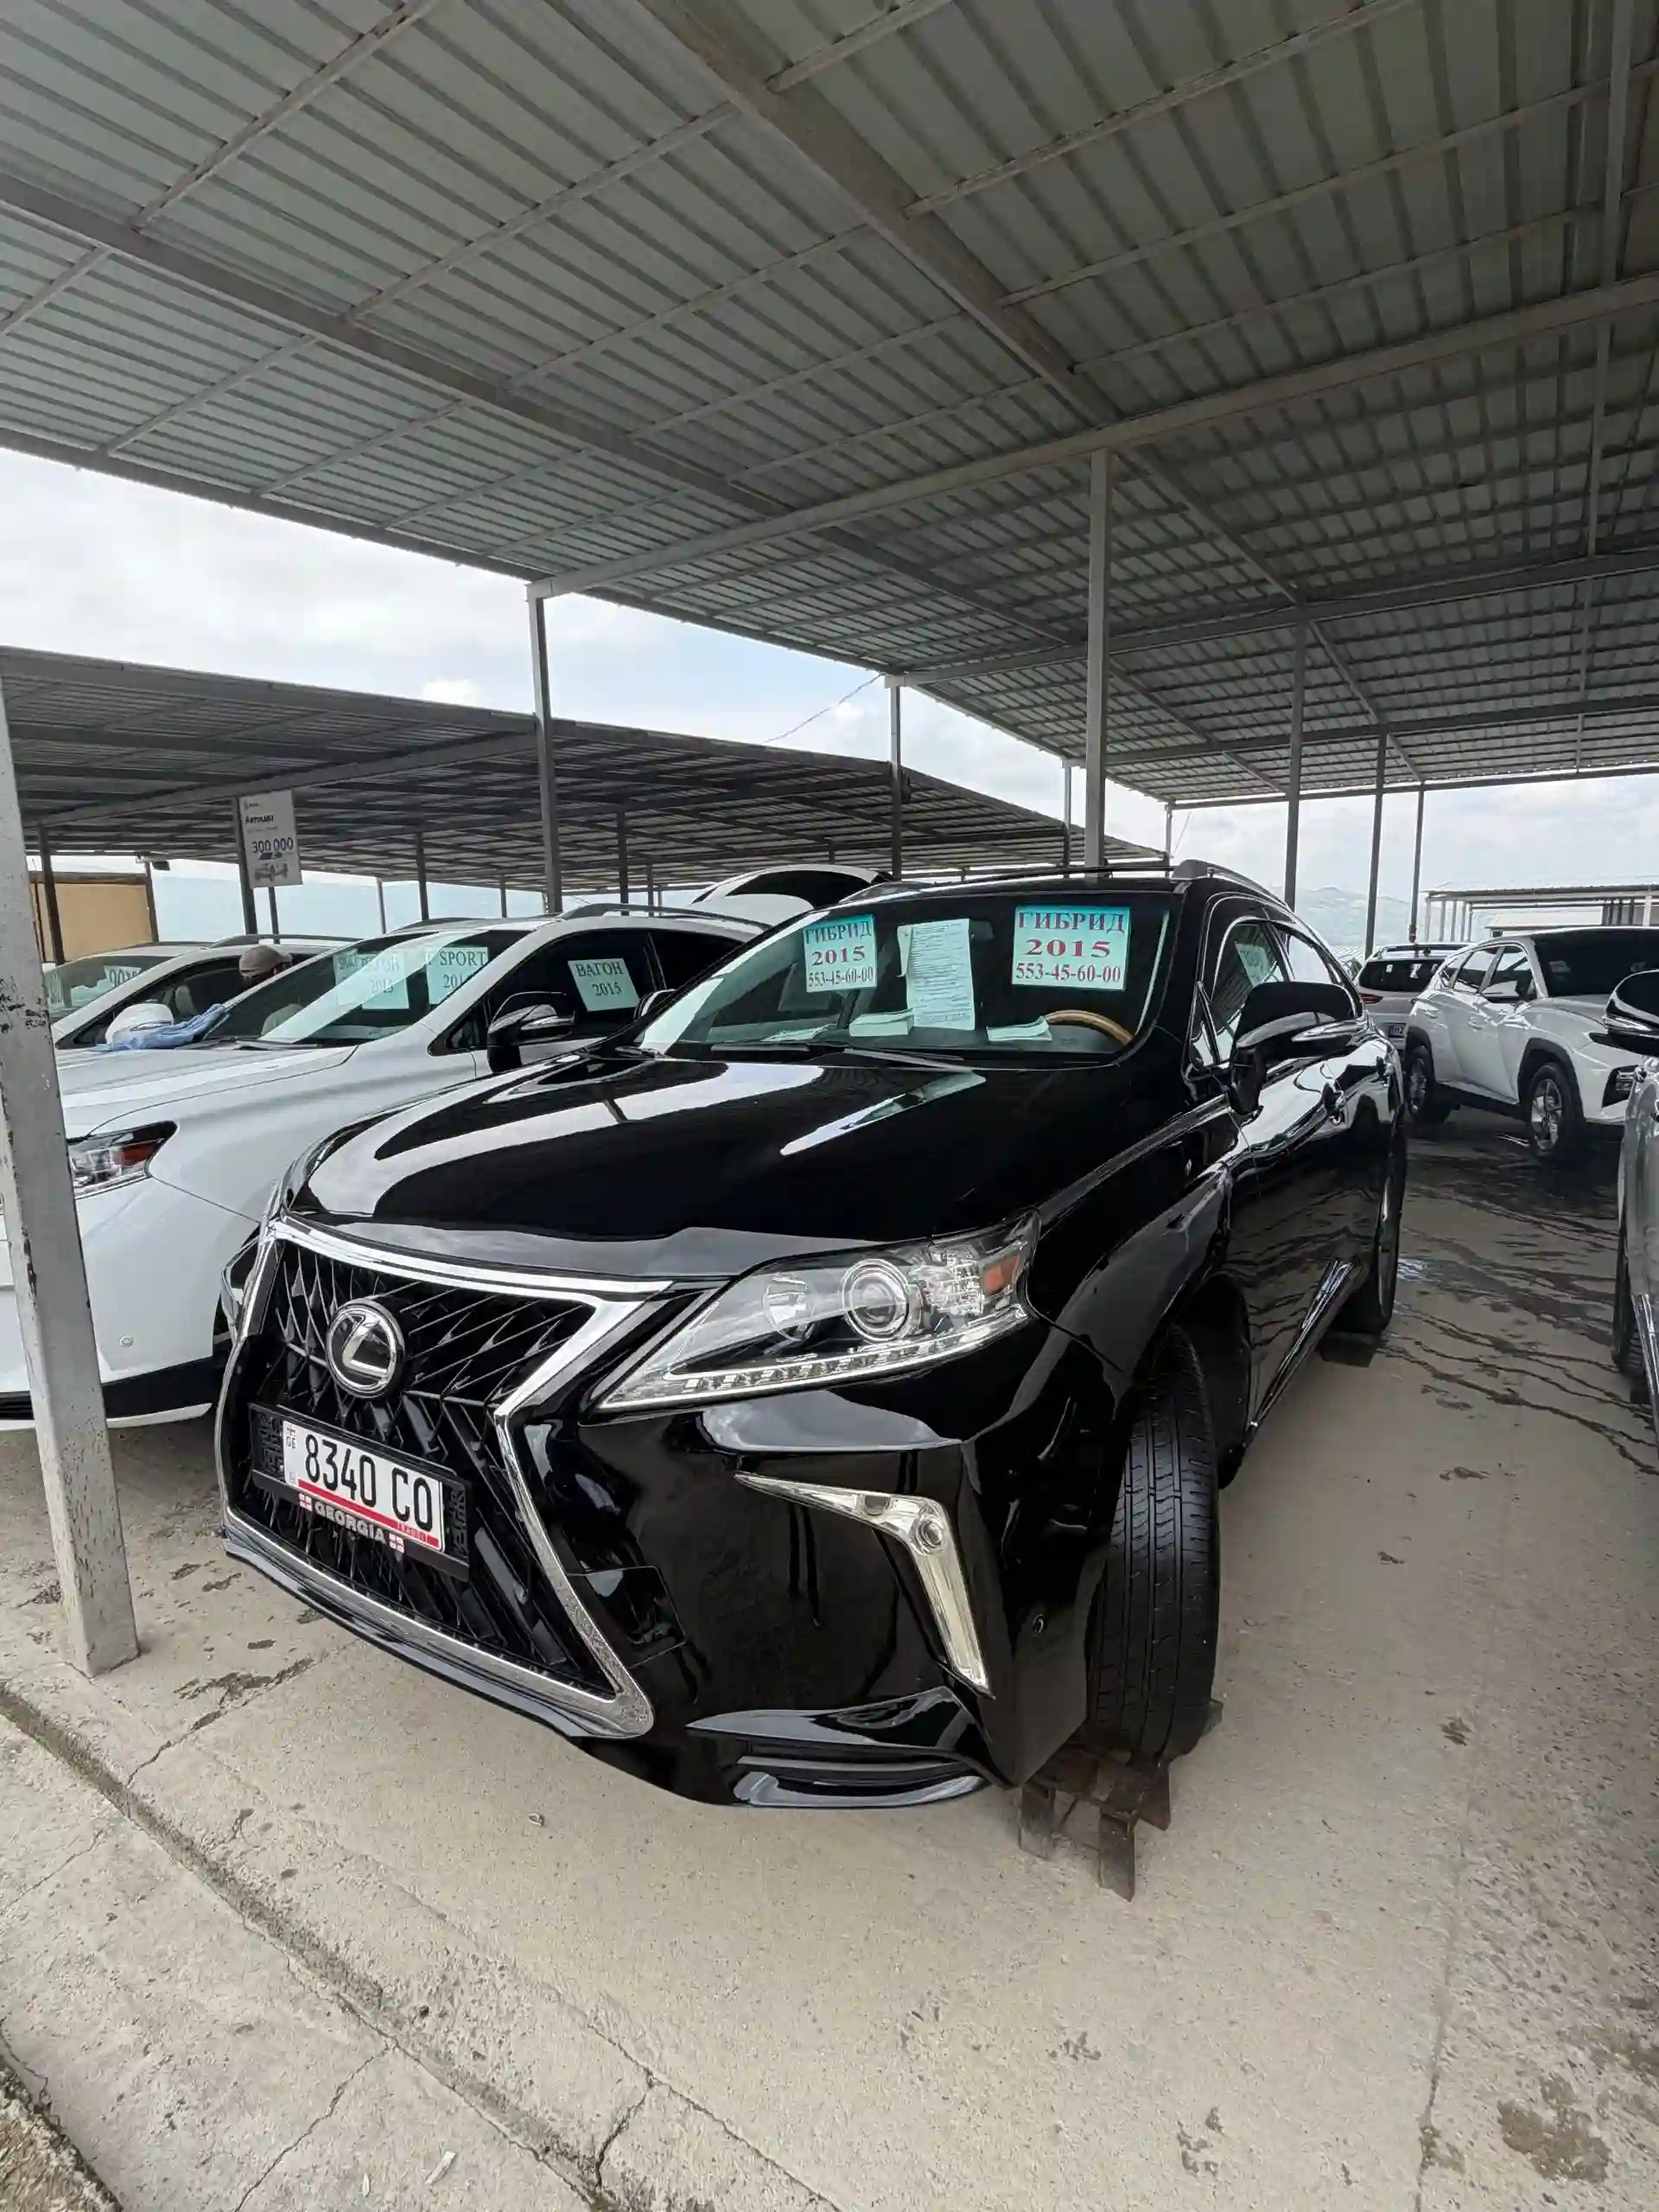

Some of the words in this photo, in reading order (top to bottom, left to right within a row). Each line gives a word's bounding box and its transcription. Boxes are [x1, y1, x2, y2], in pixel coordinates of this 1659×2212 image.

[251, 839, 271, 854] 300
[273, 836, 294, 852] 000
[805, 920, 872, 944] ГИБРИД
[1019, 912, 1125, 934] ГИБРИД
[811, 945, 866, 966] 2015
[1022, 938, 1111, 958] 2015
[439, 950, 487, 968] SPORT
[575, 961, 626, 977] ВАГОН
[809, 966, 874, 988] 553-45-60-00
[1015, 962, 1122, 983] 553-45-60-00
[591, 981, 622, 996] 2015
[305, 1433, 377, 1508] 8340
[391, 1466, 433, 1532] CO
[315, 1500, 387, 1545] GEORGIA
